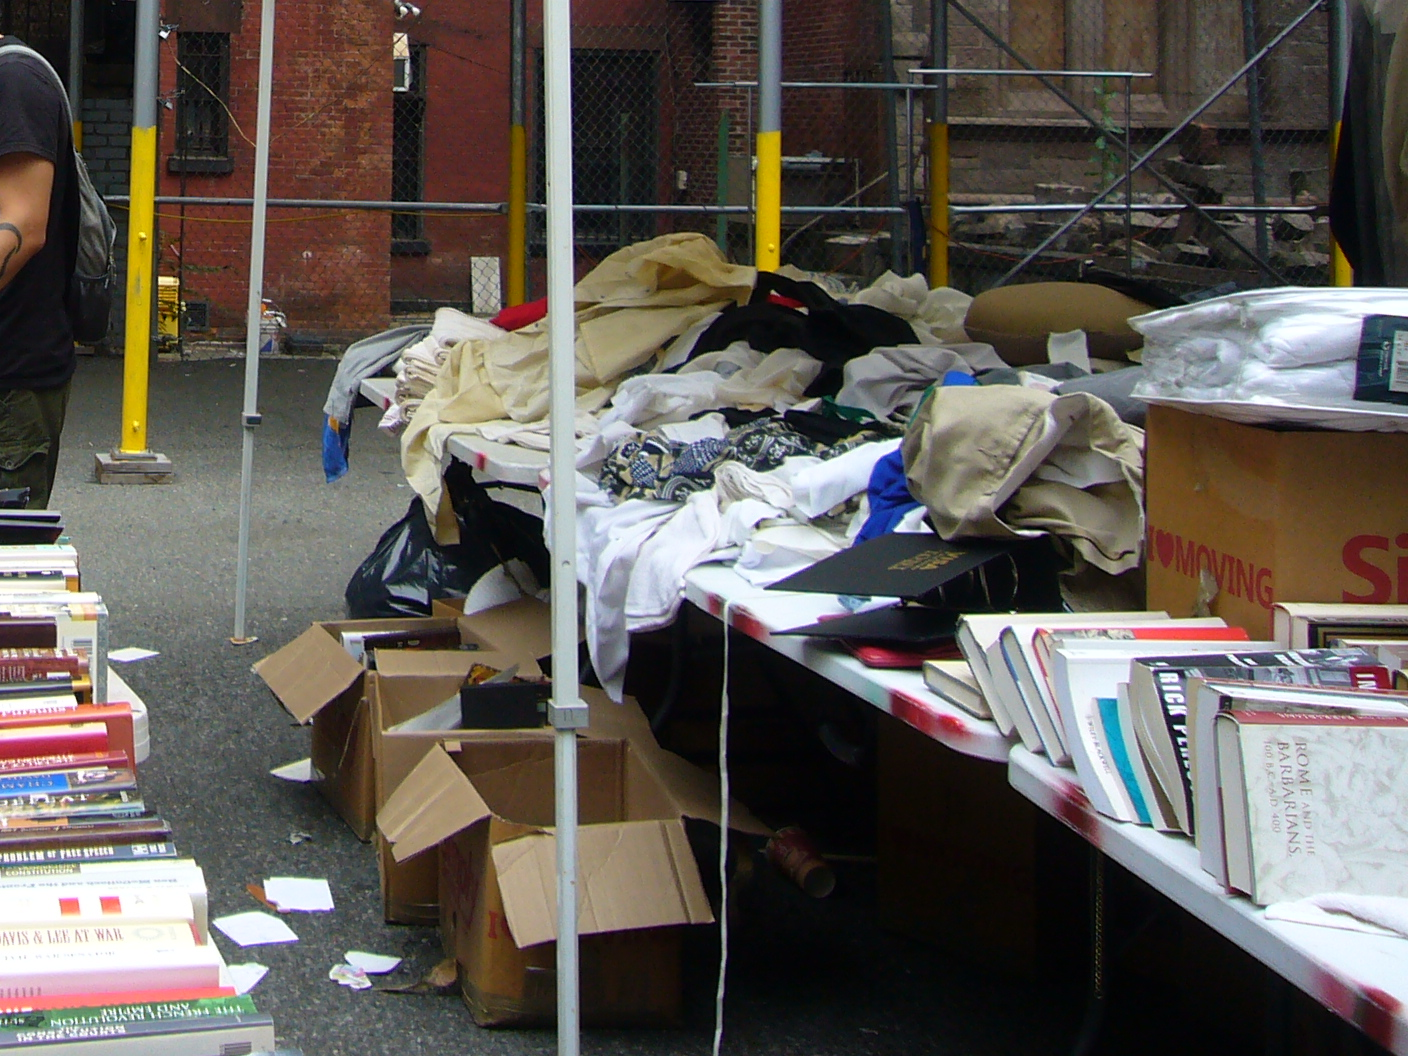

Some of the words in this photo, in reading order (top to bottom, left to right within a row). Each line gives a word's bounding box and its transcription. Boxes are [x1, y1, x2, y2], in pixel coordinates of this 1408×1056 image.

[1176, 534, 1273, 610] MOVING
[1159, 672, 1187, 717] RICK
[3, 706, 66, 717] Pursuits
[1295, 742, 1313, 799] ROME
[1271, 811, 1280, 834] 400
[1302, 801, 1312, 833] AND
[83, 846, 114, 858] SPEECH
[1305, 836, 1316, 856] THE
[33, 929, 44, 945] &
[47, 928, 71, 944] LEE
[74, 927, 91, 943] AT
[93, 926, 125, 942] WAR
[100, 1004, 151, 1017] EMPIRE
[151, 1006, 211, 1019] FRENCH
[157, 1001, 190, 1012] AND
[215, 1003, 243, 1014] THE
[49, 1011, 147, 1027] REVOLUTION
